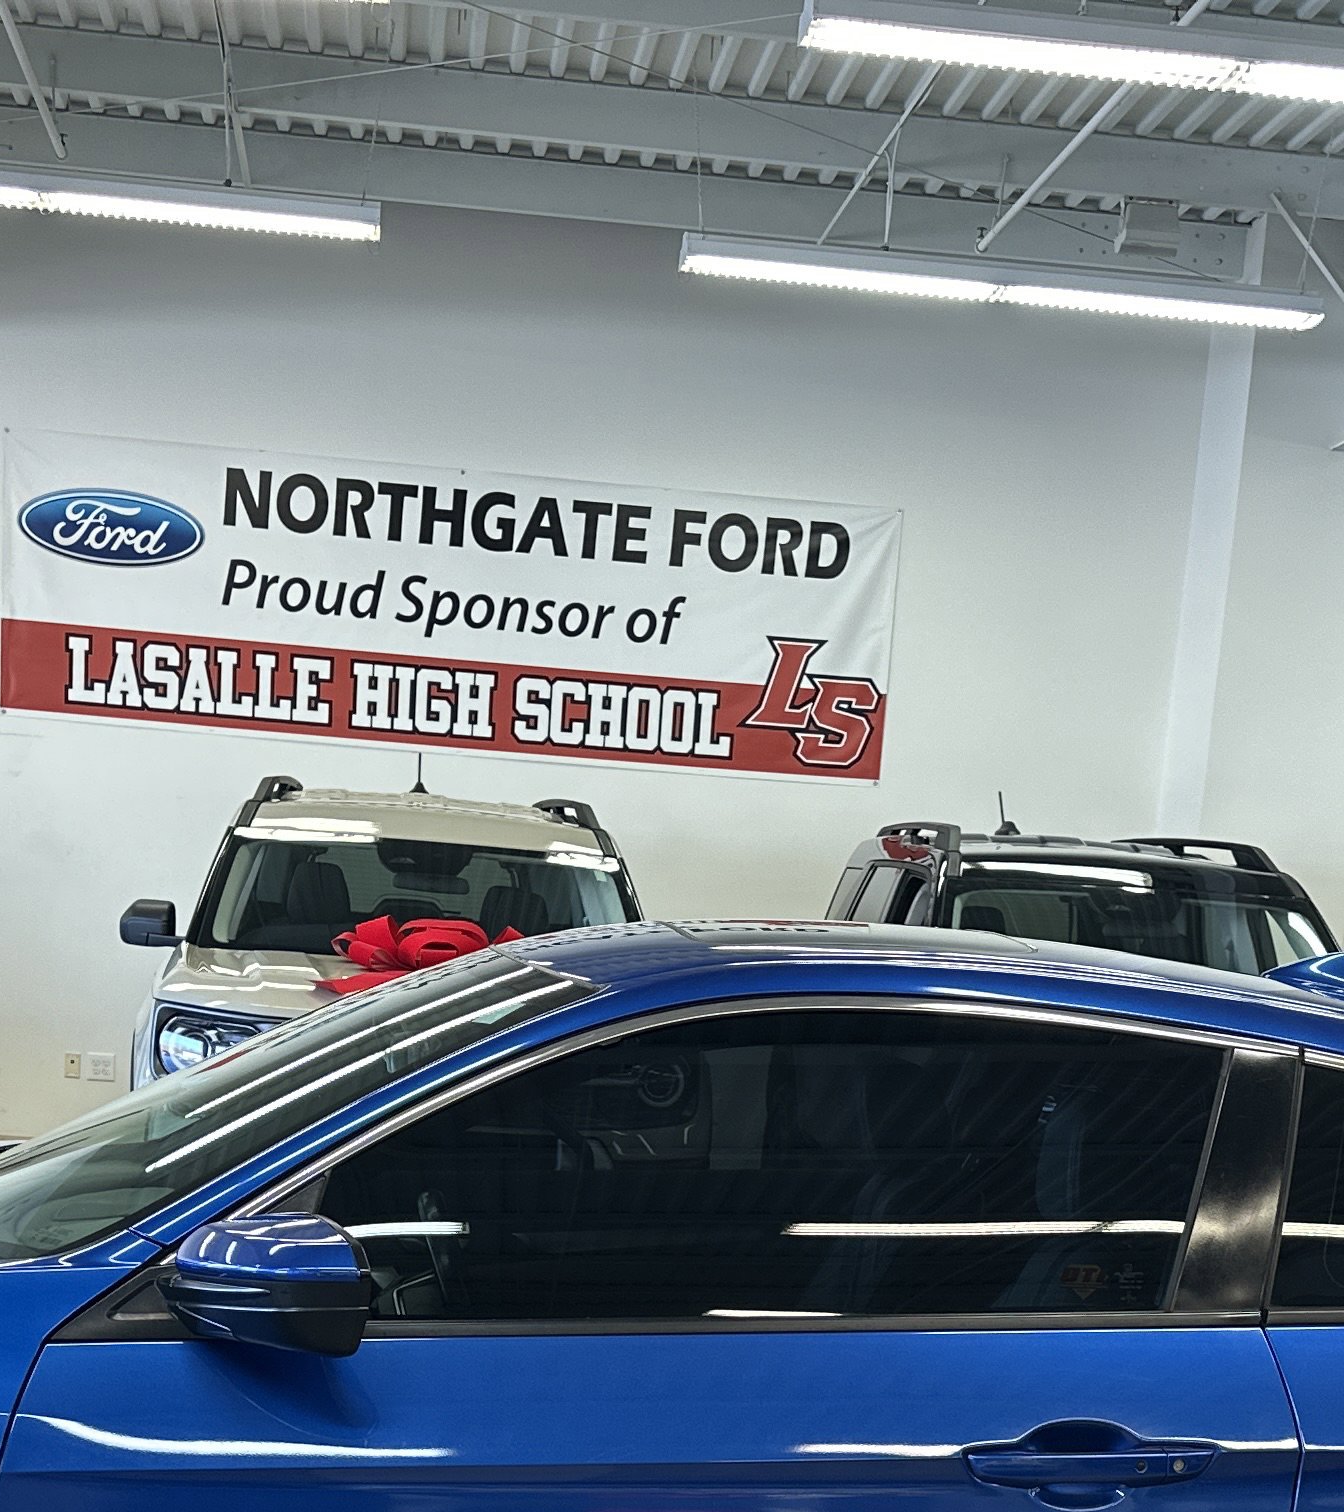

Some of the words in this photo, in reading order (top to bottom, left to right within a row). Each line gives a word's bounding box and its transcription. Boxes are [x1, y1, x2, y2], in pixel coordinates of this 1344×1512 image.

[52, 498, 169, 557] Ford
[222, 467, 650, 565] NORTHGATE
[668, 509, 851, 580] FORD
[222, 559, 386, 621] Proud
[395, 575, 616, 638] Sponsor
[625, 595, 686, 645] of
[64, 633, 333, 726] LASALLE
[350, 656, 496, 740] HIGH
[513, 674, 734, 760] SCHOOL
[739, 635, 883, 768] LS
